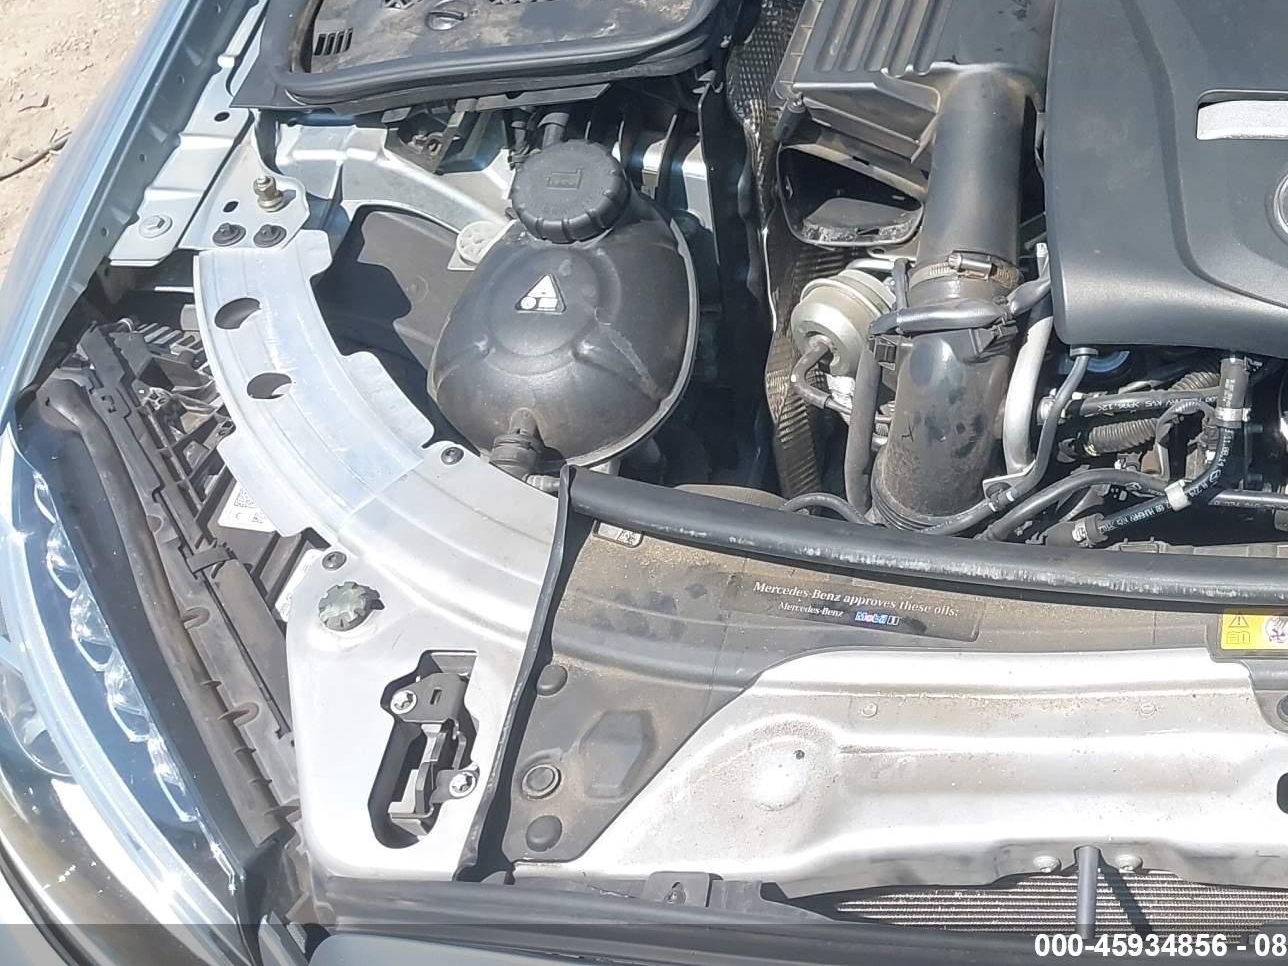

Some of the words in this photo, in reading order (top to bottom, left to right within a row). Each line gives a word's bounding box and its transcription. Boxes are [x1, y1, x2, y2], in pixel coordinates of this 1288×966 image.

[753, 581, 841, 603] Mercedes-Benz
[843, 595, 896, 610] approves
[899, 600, 931, 614] these
[778, 601, 844, 618] Mercedes-Benz
